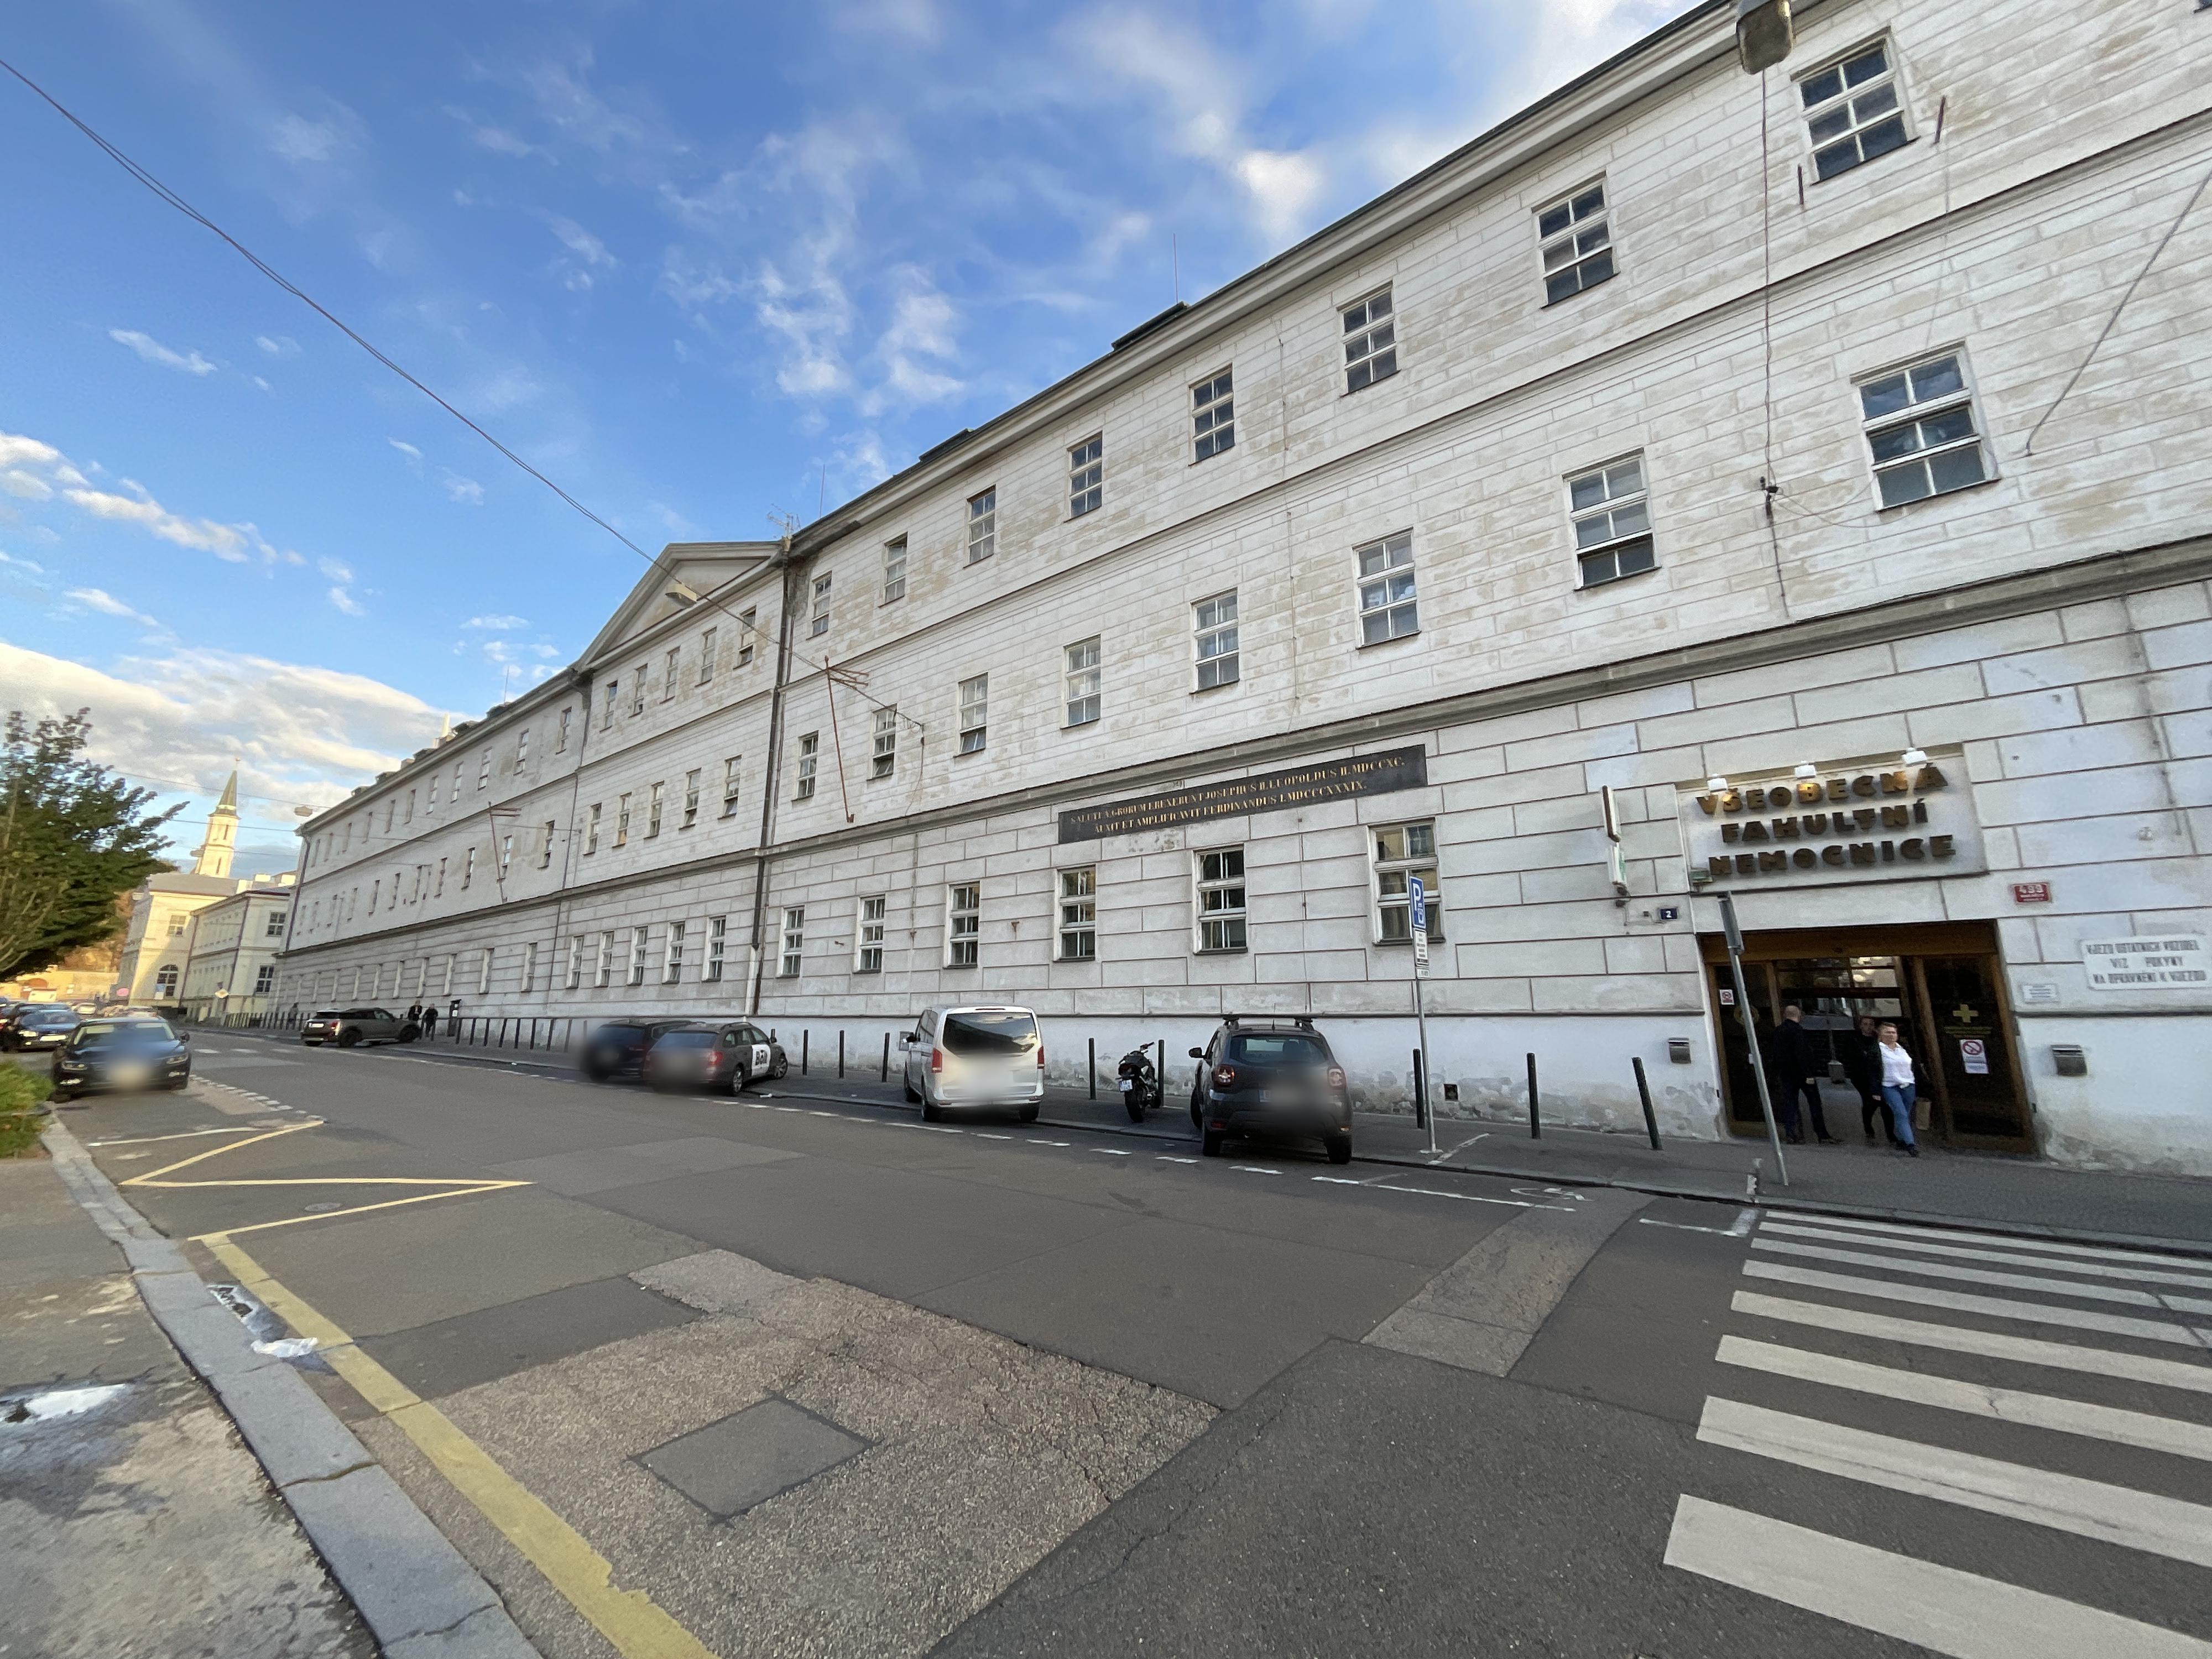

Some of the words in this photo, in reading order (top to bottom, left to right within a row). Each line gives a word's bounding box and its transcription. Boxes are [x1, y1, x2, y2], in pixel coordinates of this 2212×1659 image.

[1205, 783, 1256, 800] JOSEPHUS
[1270, 768, 1337, 789] LEOPOLDUS
[1695, 763, 1948, 815] VŠEOBECNÁ
[1203, 795, 1277, 815] FERDINANDUS
[1721, 797, 1928, 842] FAKULTNÍ
[1709, 834, 1956, 875] NEMOCNICE
[1412, 883, 1421, 911] P
